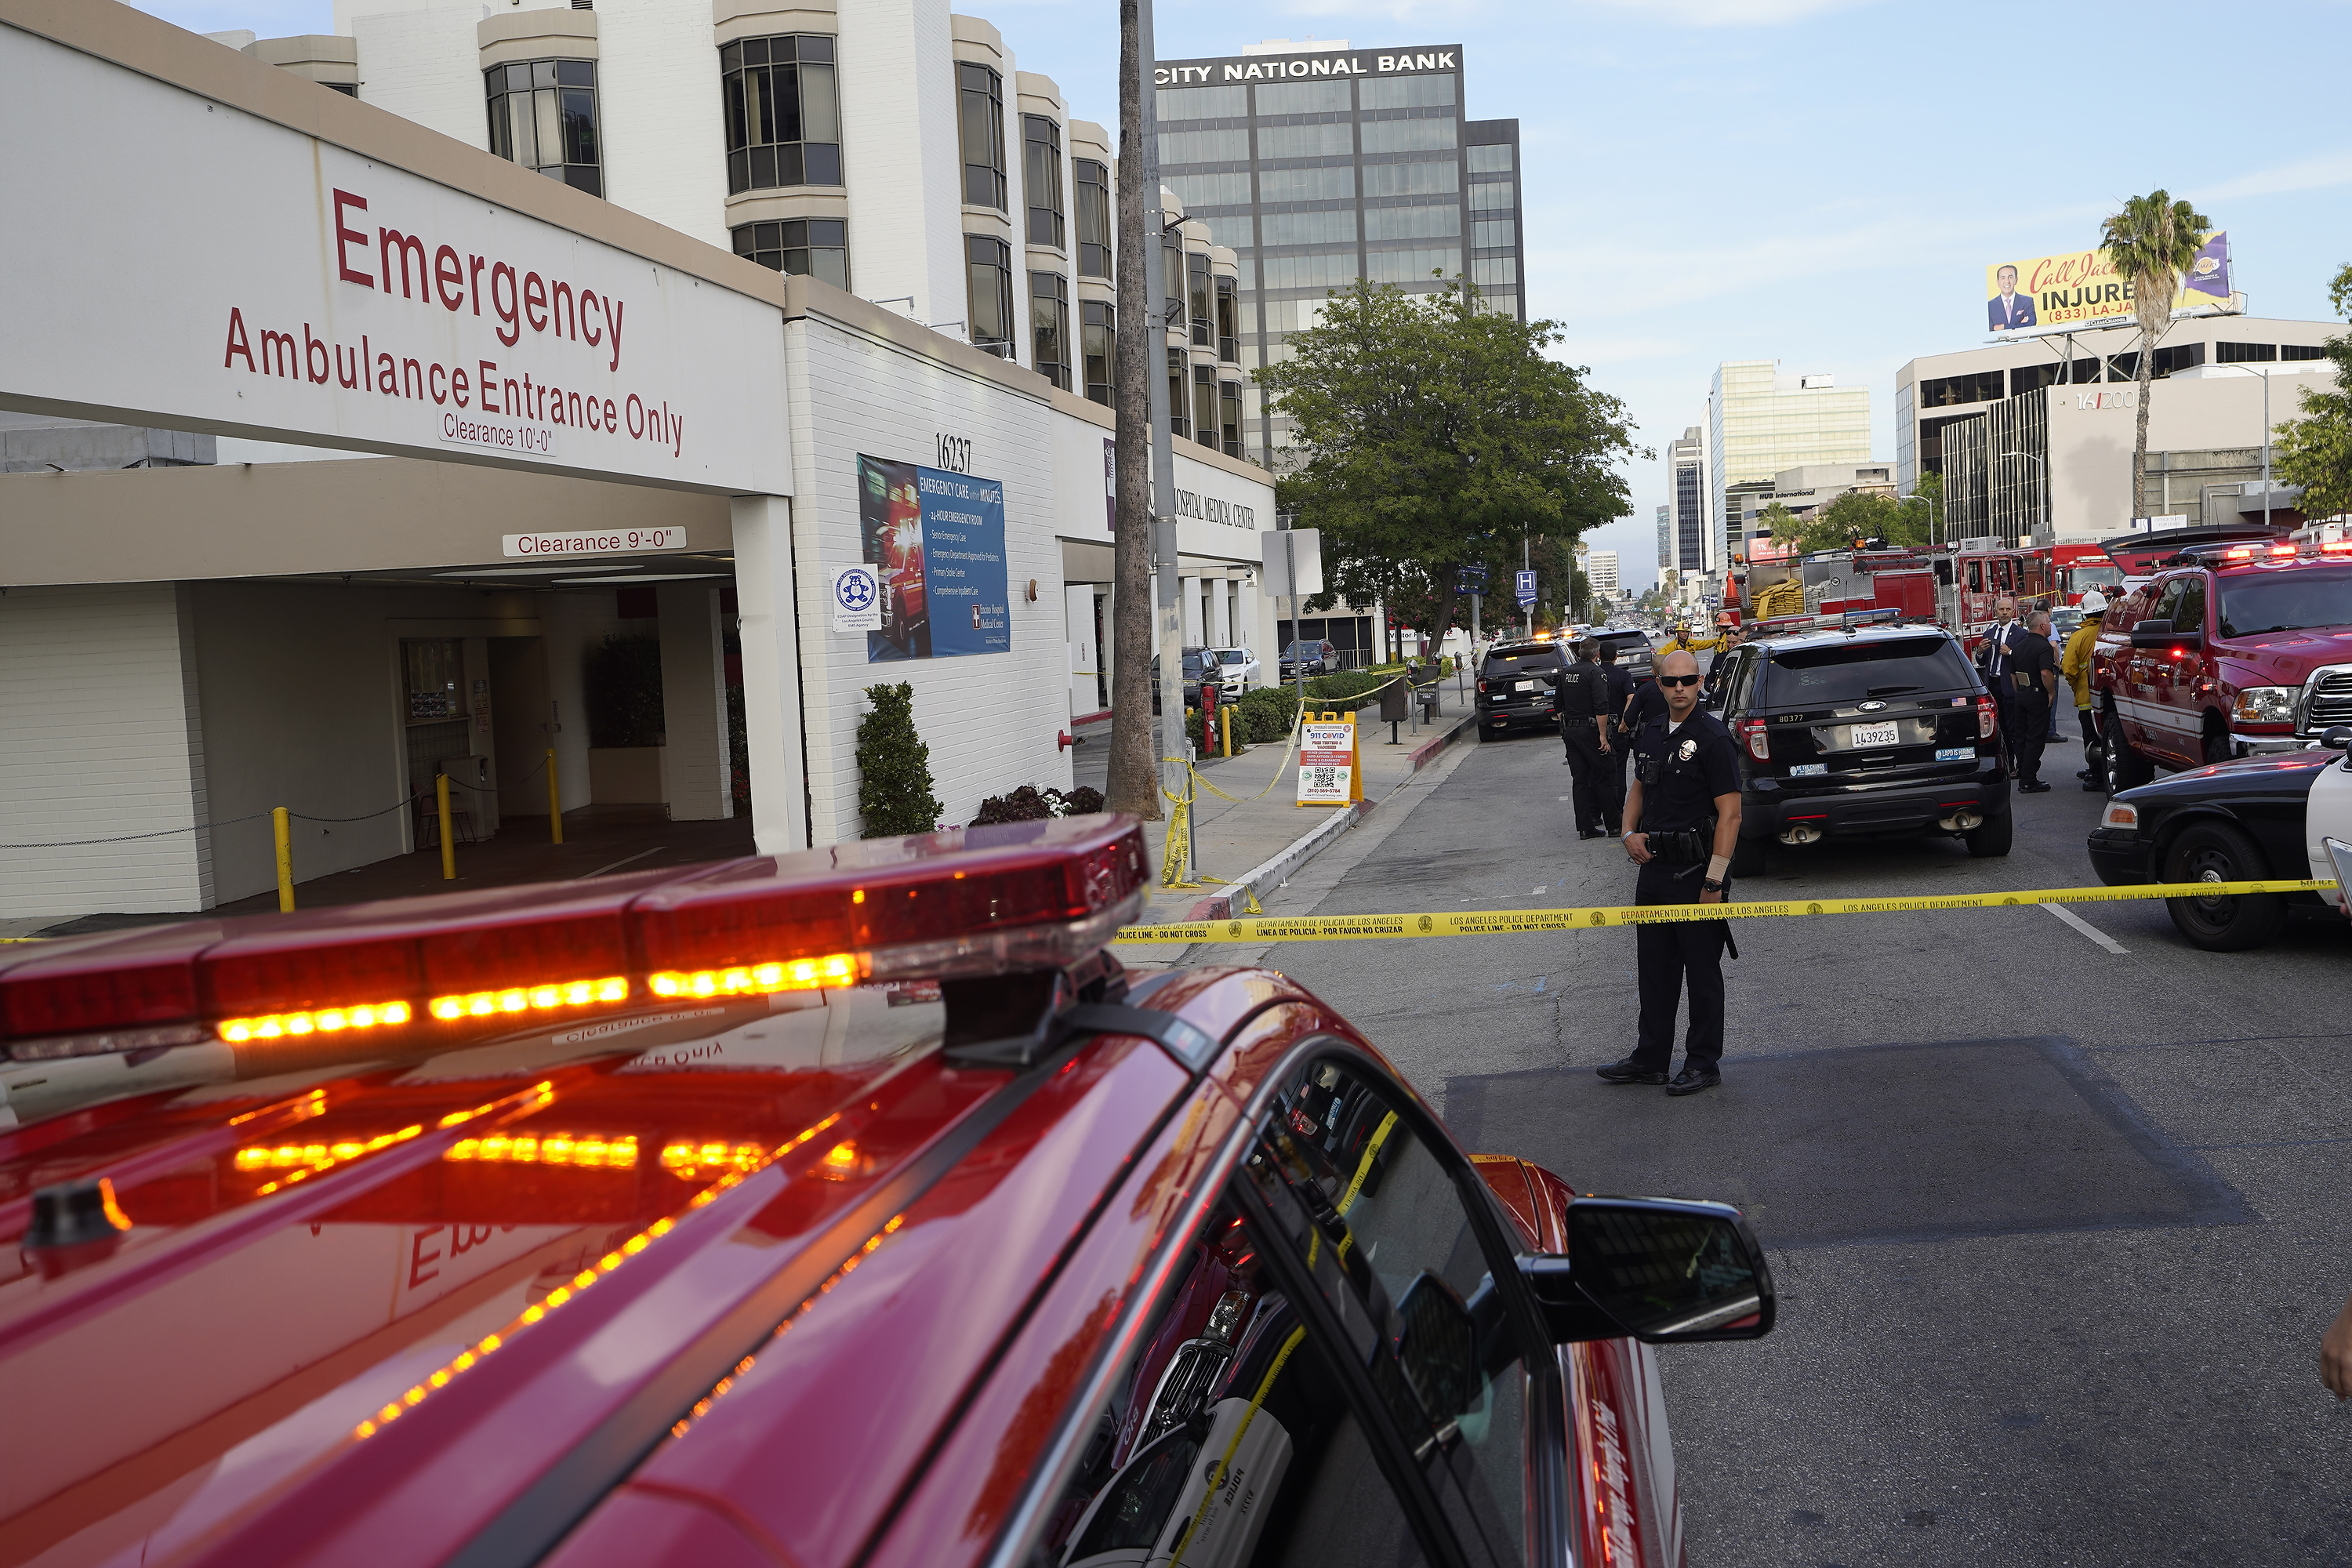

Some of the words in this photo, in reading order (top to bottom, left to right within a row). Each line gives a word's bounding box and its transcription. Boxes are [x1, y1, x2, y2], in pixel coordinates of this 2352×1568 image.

[1155, 67, 1212, 85] CITY
[1224, 58, 1367, 81] NATIONAL
[1377, 52, 1457, 72] BANK
[332, 187, 624, 372] Emergency
[2030, 259, 2075, 294] Call
[2042, 281, 2135, 310] INJURE
[2049, 307, 2087, 322] (833)
[2092, 302, 2134, 315] LA-JA
[225, 307, 470, 408] Ambulance
[479, 360, 618, 434] Entrance
[626, 394, 683, 458] Only
[2076, 391, 2136, 410] 16/200
[444, 412, 514, 445] Clearance
[518, 428, 553, 452] 10'-0"
[936, 432, 971, 474] 16237
[920, 477, 954, 497] EMERGENCY
[955, 483, 969, 499] CARE
[979, 488, 1002, 504] MINUTES.
[1174, 488, 1203, 520] OSPITAL
[1204, 496, 1232, 526] MEDICAL
[1233, 503, 1255, 531] CENTER
[931, 510, 948, 523] 24-HOUR
[949, 512, 971, 524] EMERGENCY
[971, 514, 983, 526] ROOM
[518, 532, 621, 554] Clearance
[627, 529, 673, 549] 9'-0"
[931, 529, 942, 539] Senior
[942, 531, 959, 544] Emergency
[932, 548, 949, 561] Emergency
[949, 550, 968, 561] Department
[968, 551, 982, 563] Approved
[985, 552, 1000, 562] Pediatrics
[933, 567, 946, 579] Primary
[955, 568, 966, 578] Center
[1519, 574, 1532, 589] H
[935, 585, 958, 598] Comprehensive
[958, 586, 971, 598] Inpatient
[980, 604, 991, 615] Encino
[991, 604, 1004, 616] Hospital
[980, 618, 993, 629] Medical
[993, 618, 1004, 628] Center
[1565, 673, 1580, 683] POLICE
[1779, 714, 1803, 723] 80377
[1855, 730, 1896, 744] 1439235
[1860, 902, 1897, 912] ANGELES
[1899, 901, 1928, 910] POLICE
[1929, 899, 1984, 909] DEPARTMENT
[2038, 895, 2105, 904] DEPARTAMENTO
[1450, 916, 1465, 925] LOS
[1465, 916, 1497, 925] ANGELES
[1499, 915, 1525, 924] POLICE
[1526, 913, 1573, 923] DEPARTMENT
[1621, 910, 1679, 920] DEPARTAMENTO
[1693, 908, 1722, 916] POLICIA
[1725, 907, 1735, 916] DE
[1737, 906, 1752, 915] LOS
[1754, 905, 1789, 913] ANGELES
[1256, 919, 1308, 928] DEPARTAMENTO
[1308, 918, 1319, 927] DE
[1321, 918, 1347, 927] POLICIA
[1348, 917, 1357, 926] DE
[1358, 917, 1371, 926] LOS
[1373, 916, 1403, 925] ANGELES
[1257, 928, 1276, 937] LINEA
[1277, 927, 1288, 936] DE
[1289, 927, 1317, 936] POLICIA
[1339, 927, 1362, 935] FAVOR
[1374, 926, 1403, 935] CRUZAR
